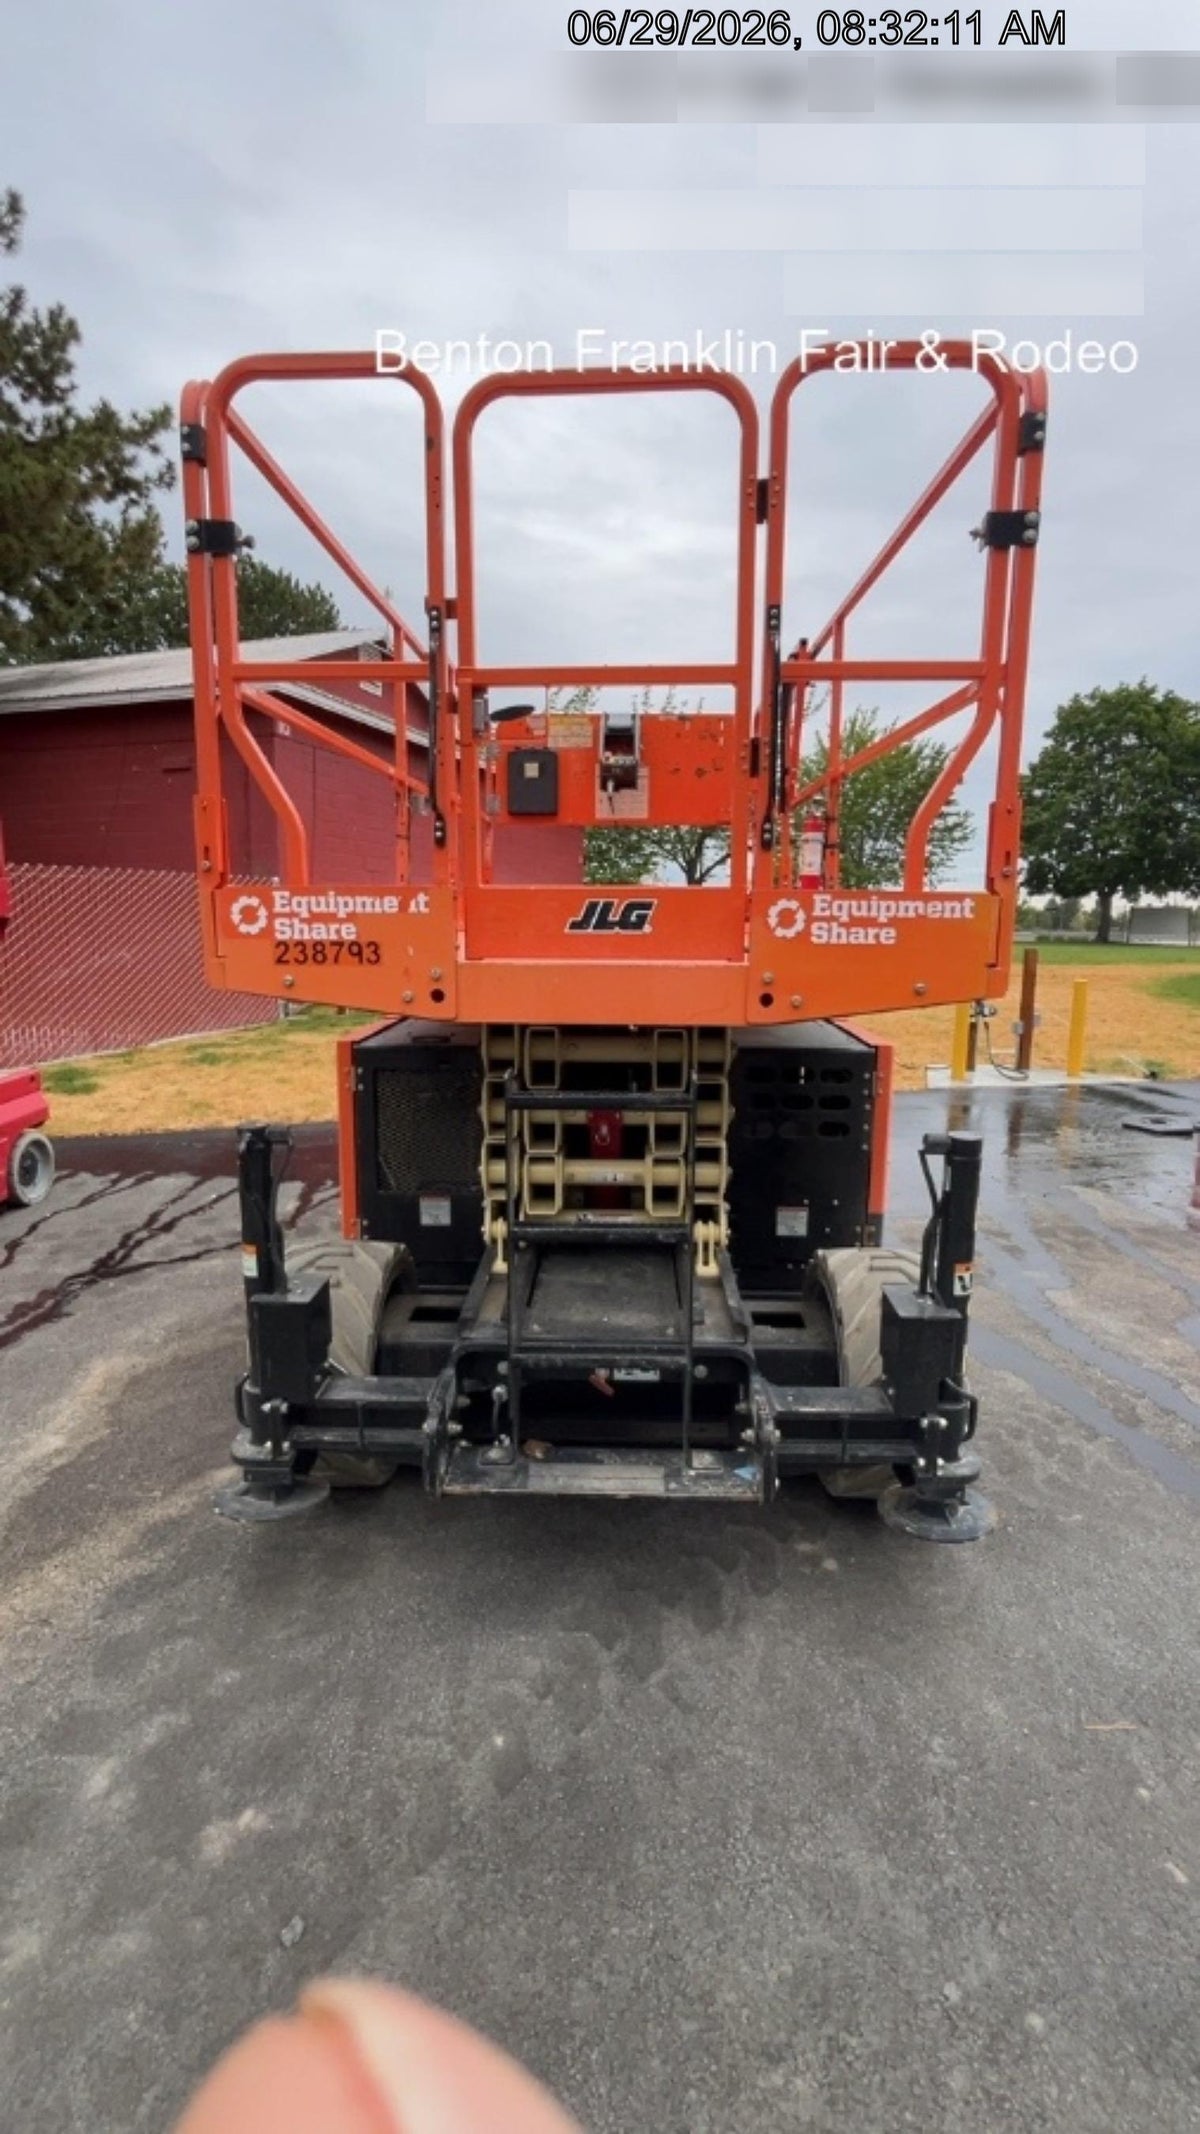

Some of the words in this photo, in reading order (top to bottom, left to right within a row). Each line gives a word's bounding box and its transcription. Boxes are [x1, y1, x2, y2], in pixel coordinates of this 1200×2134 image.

[564, 898, 657, 934] JLG
[812, 894, 975, 923] Equipment
[274, 917, 357, 940] Share
[810, 921, 896, 945] Share
[274, 941, 381, 966] 238793
